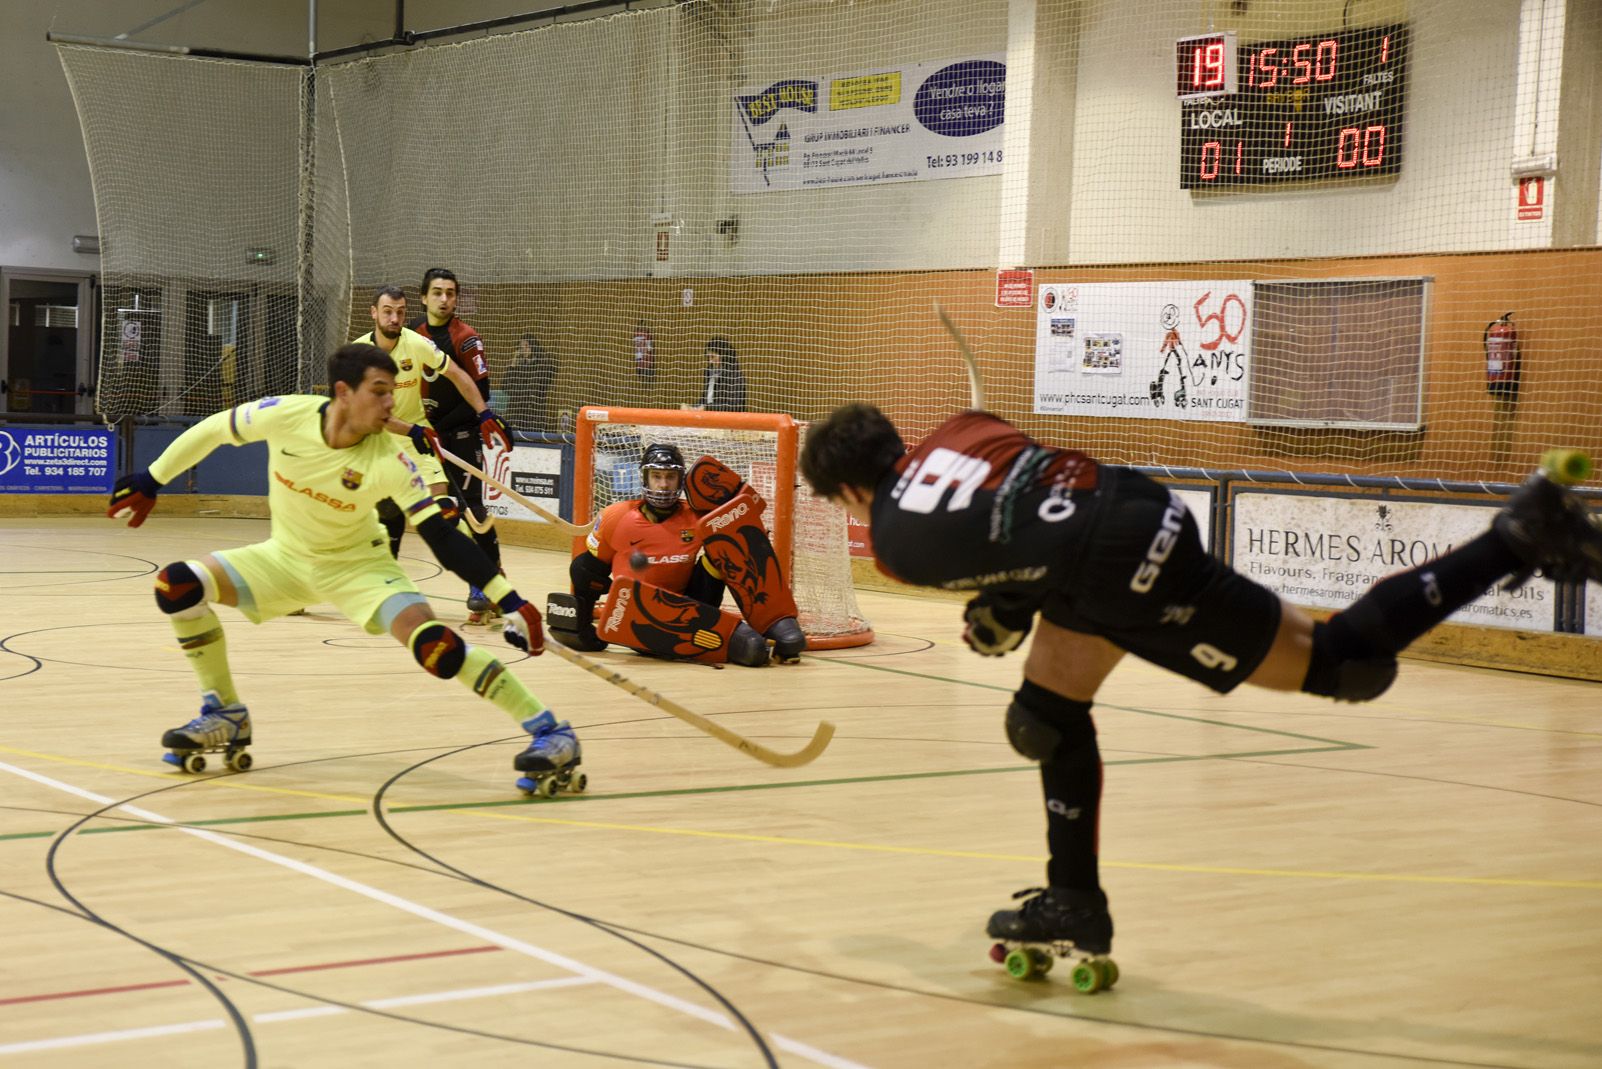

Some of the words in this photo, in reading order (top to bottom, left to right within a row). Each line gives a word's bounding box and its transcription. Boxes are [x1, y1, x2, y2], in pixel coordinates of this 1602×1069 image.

[1193, 43, 1224, 87] 19
[1249, 40, 1337, 88] 15:50
[1382, 36, 1388, 63] 1
[1363, 71, 1394, 85] FALTES
[928, 83, 965, 99] Vendre
[967, 85, 974, 96] o
[1324, 91, 1383, 115] VISITANT
[940, 109, 961, 120] casa
[964, 105, 986, 118] teva
[1190, 108, 1243, 130] LOCAL
[874, 123, 911, 137] FINANCER
[1284, 122, 1292, 148] 1
[926, 155, 944, 169] Tel:
[945, 154, 958, 167] 93
[961, 152, 980, 166] 199
[983, 151, 994, 164] 14
[996, 150, 1003, 163] 8
[1200, 142, 1243, 180] 01
[1337, 125, 1385, 169] 00
[1262, 156, 1303, 173] PERIODE
[1194, 291, 1247, 350] 50
[1039, 391, 1151, 408] www.phcsantcugat.com
[1191, 397, 1214, 409] SANT
[1216, 398, 1245, 410] CUGAT
[24, 433, 108, 447] ARTÍCULOS
[24, 447, 108, 458] PUBLICITARIOS
[24, 466, 41, 475] Tel.
[45, 467, 64, 476] 934
[67, 467, 85, 476] 185
[88, 467, 107, 476] 707
[1247, 527, 1361, 563] HERMES
[1370, 538, 1453, 569] AROM
[1322, 567, 1385, 586] Fragran
[548, 602, 577, 618] Reno
